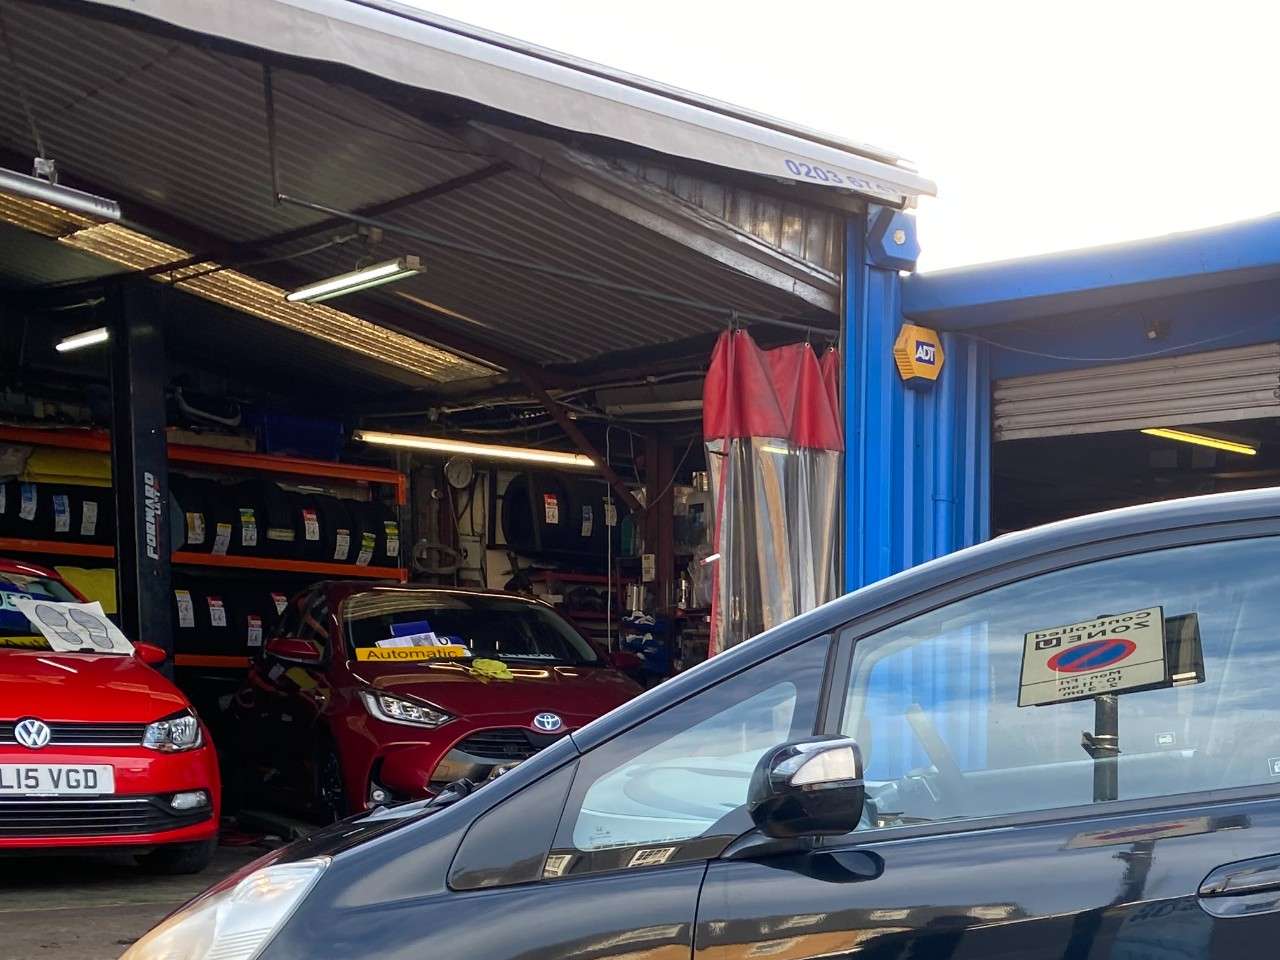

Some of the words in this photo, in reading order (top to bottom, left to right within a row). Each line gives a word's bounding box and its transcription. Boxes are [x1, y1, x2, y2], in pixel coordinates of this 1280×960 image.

[784, 158, 843, 185] 0203
[915, 345, 936, 362] ADT
[144, 471, 159, 560] FORWARD
[366, 647, 459, 661] Automatic
[50, 768, 97, 789] VGD
